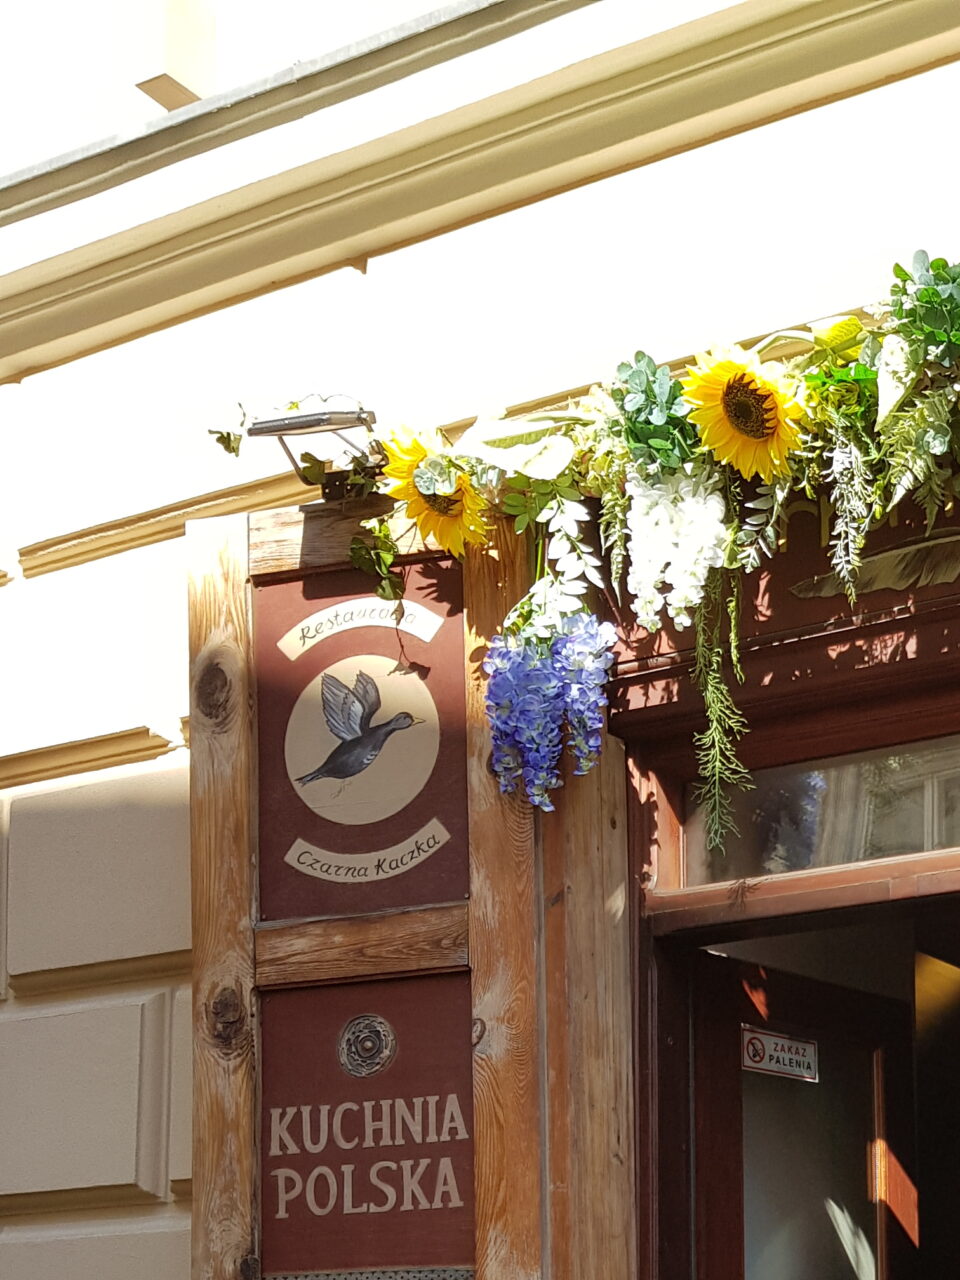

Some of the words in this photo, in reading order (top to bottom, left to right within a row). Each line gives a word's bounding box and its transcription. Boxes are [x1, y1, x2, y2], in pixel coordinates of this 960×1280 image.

[296, 850, 369, 879] Czarna
[374, 832, 441, 876] Kaczka
[769, 1055, 812, 1071] PALENIA
[774, 1043, 807, 1057] ZAKAZ
[268, 1093, 470, 1157] KUCHNIA
[270, 1157, 465, 1219] POLSKA
